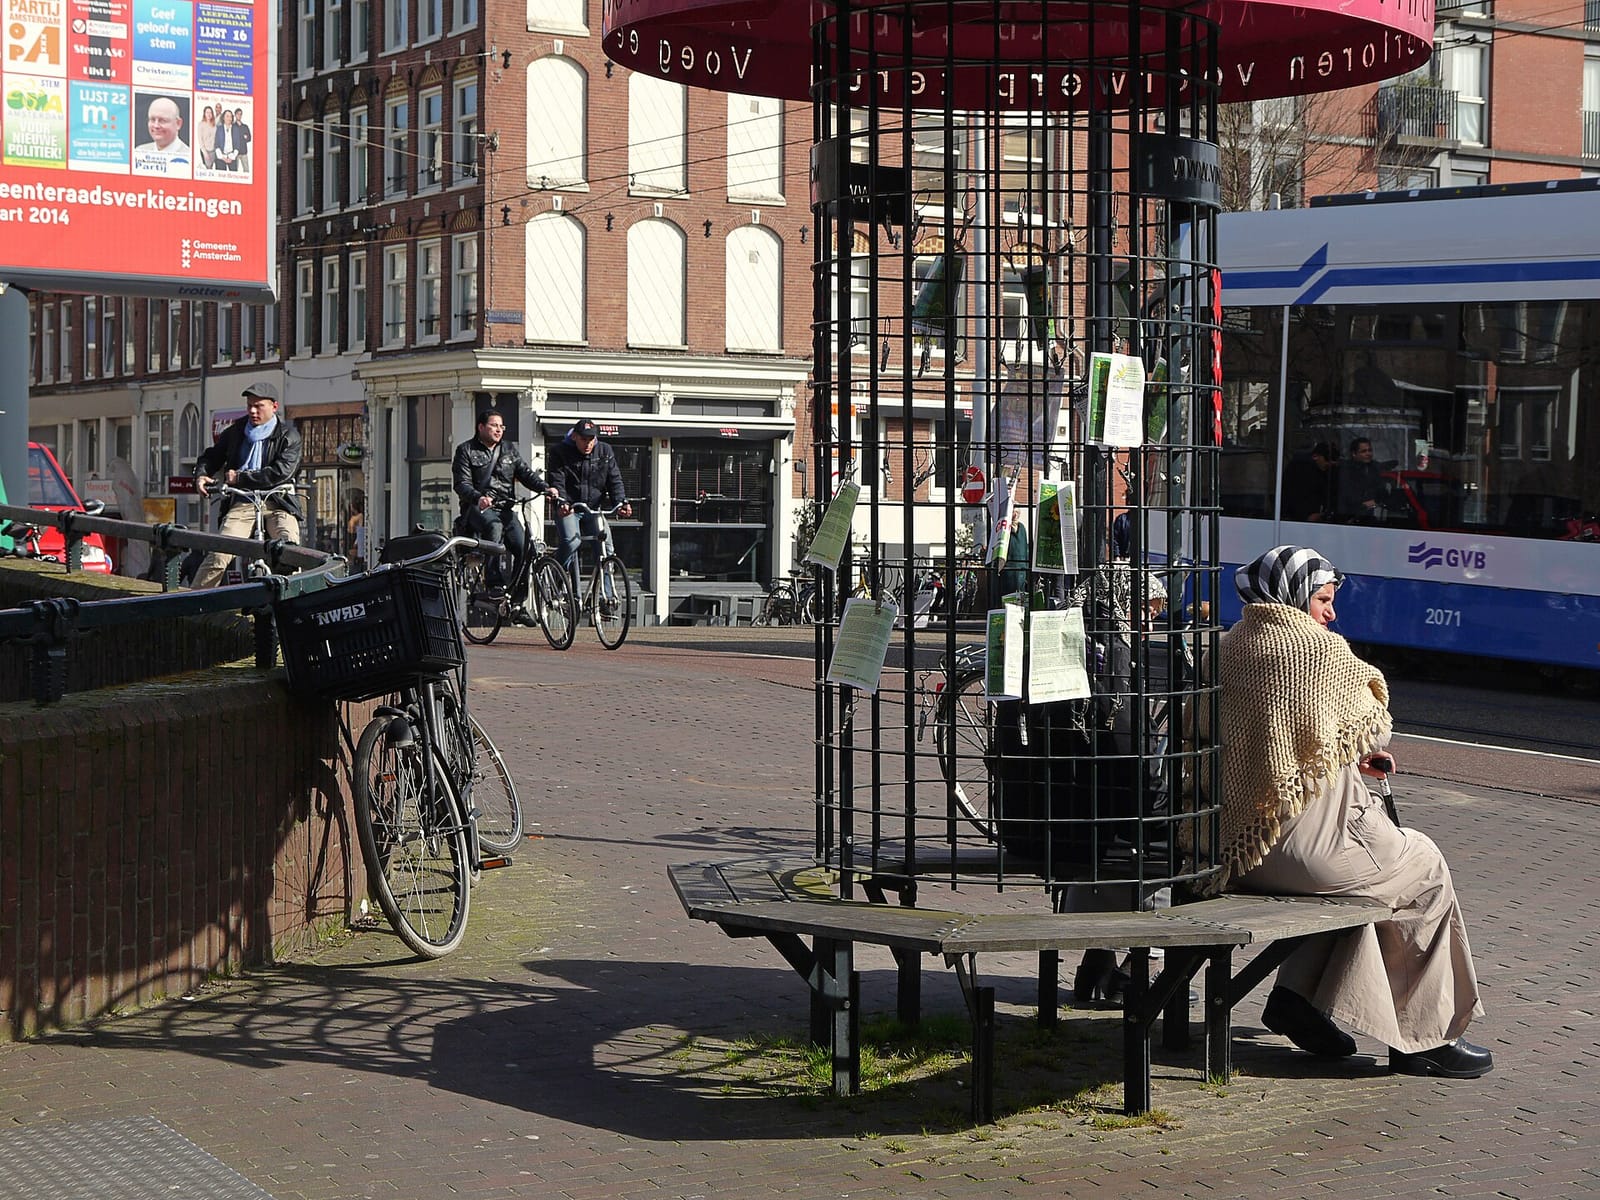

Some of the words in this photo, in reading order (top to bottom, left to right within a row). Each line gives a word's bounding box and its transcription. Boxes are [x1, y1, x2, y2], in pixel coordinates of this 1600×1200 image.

[9, 0, 60, 17] PARTIJ
[151, 7, 176, 20] Geef
[9, 12, 61, 25] AMSTERDAM
[197, 16, 252, 28] AMSTERDAM
[136, 20, 169, 34] geloof
[170, 26, 189, 37] een
[200, 25, 228, 40] LIJST
[232, 29, 248, 42] 16
[150, 37, 176, 50] stem
[41, 79, 60, 88] STEM
[79, 88, 109, 104] LIJST
[111, 92, 127, 106] 22
[12, 131, 58, 147] NIEUWE
[8, 142, 63, 160] POLITIEK!
[0, 182, 242, 218] eenteraadsverkiezingen
[0, 207, 23, 222] art
[29, 206, 70, 225] 2014
[193, 240, 237, 252] Gemeente
[193, 250, 242, 262] Amsterdam
[1446, 548, 1486, 569] GVB
[1425, 607, 1461, 627] 2071
